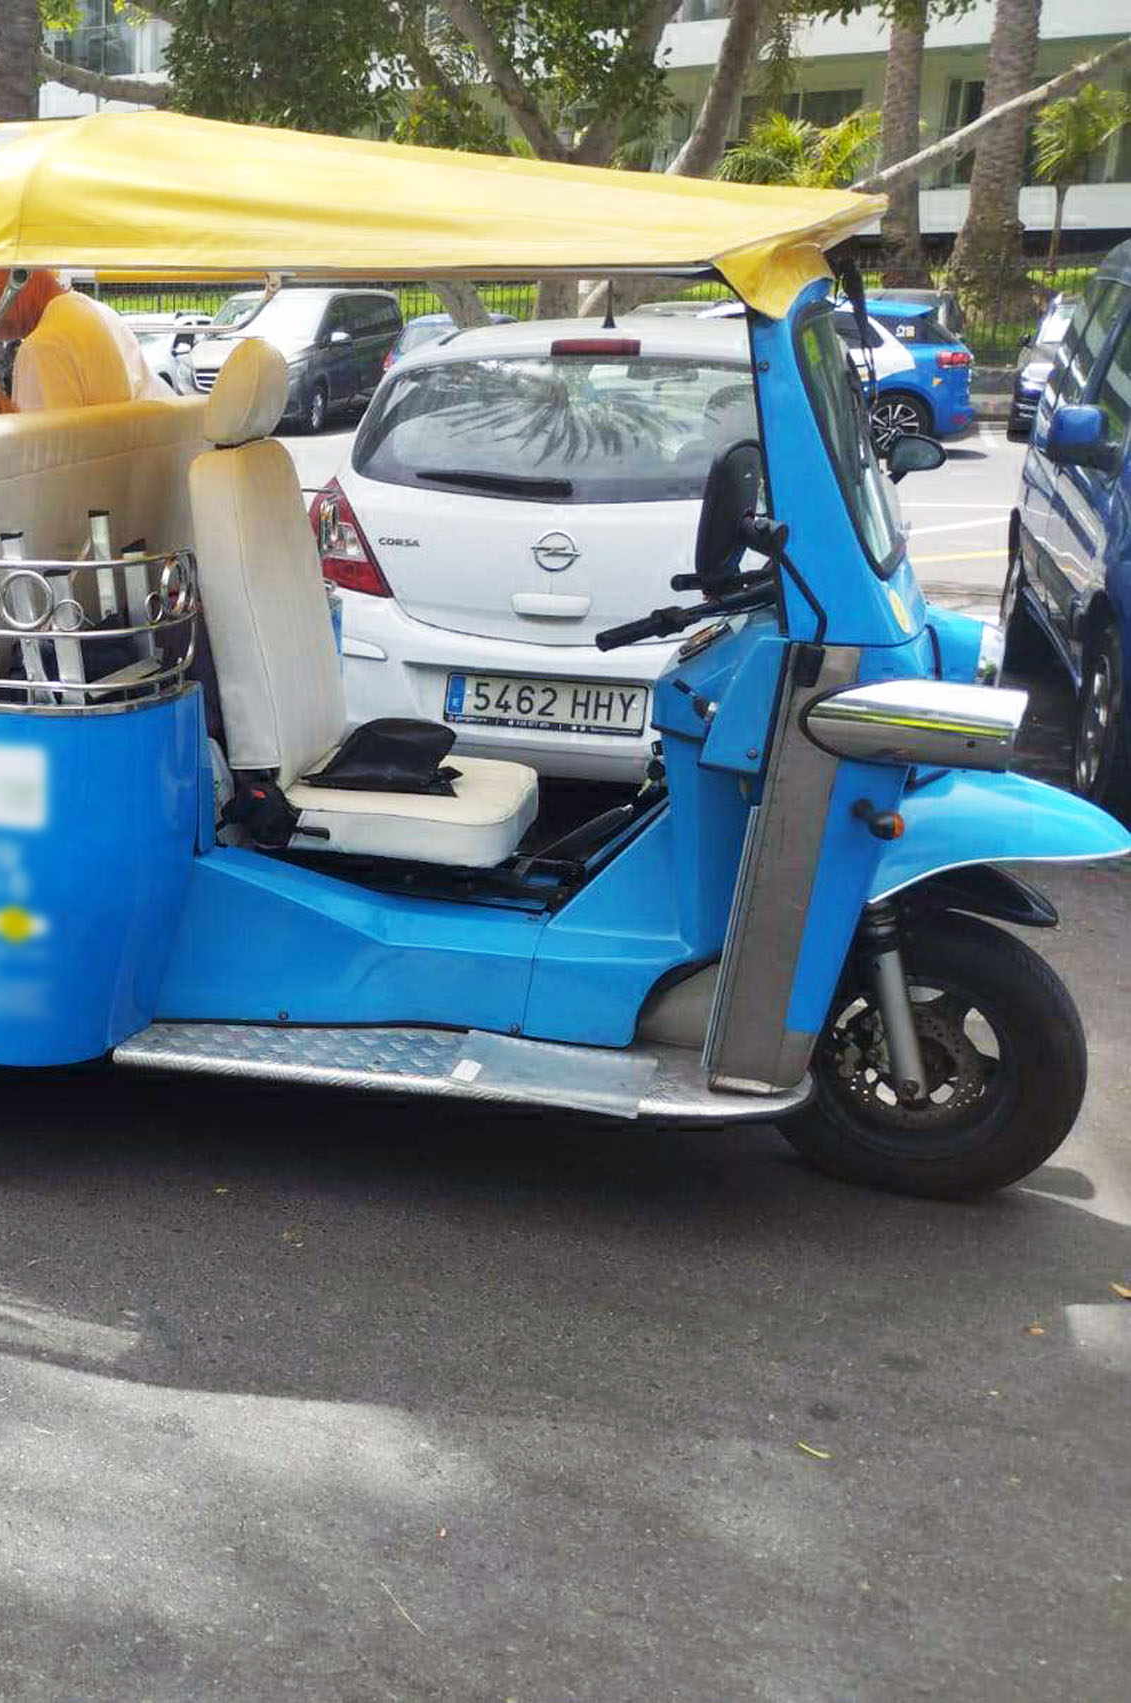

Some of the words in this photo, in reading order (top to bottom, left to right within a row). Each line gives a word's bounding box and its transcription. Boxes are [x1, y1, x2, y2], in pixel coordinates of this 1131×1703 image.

[378, 537, 420, 547] CORSA
[473, 682, 558, 718] 5462
[570, 689, 637, 722] HHY
